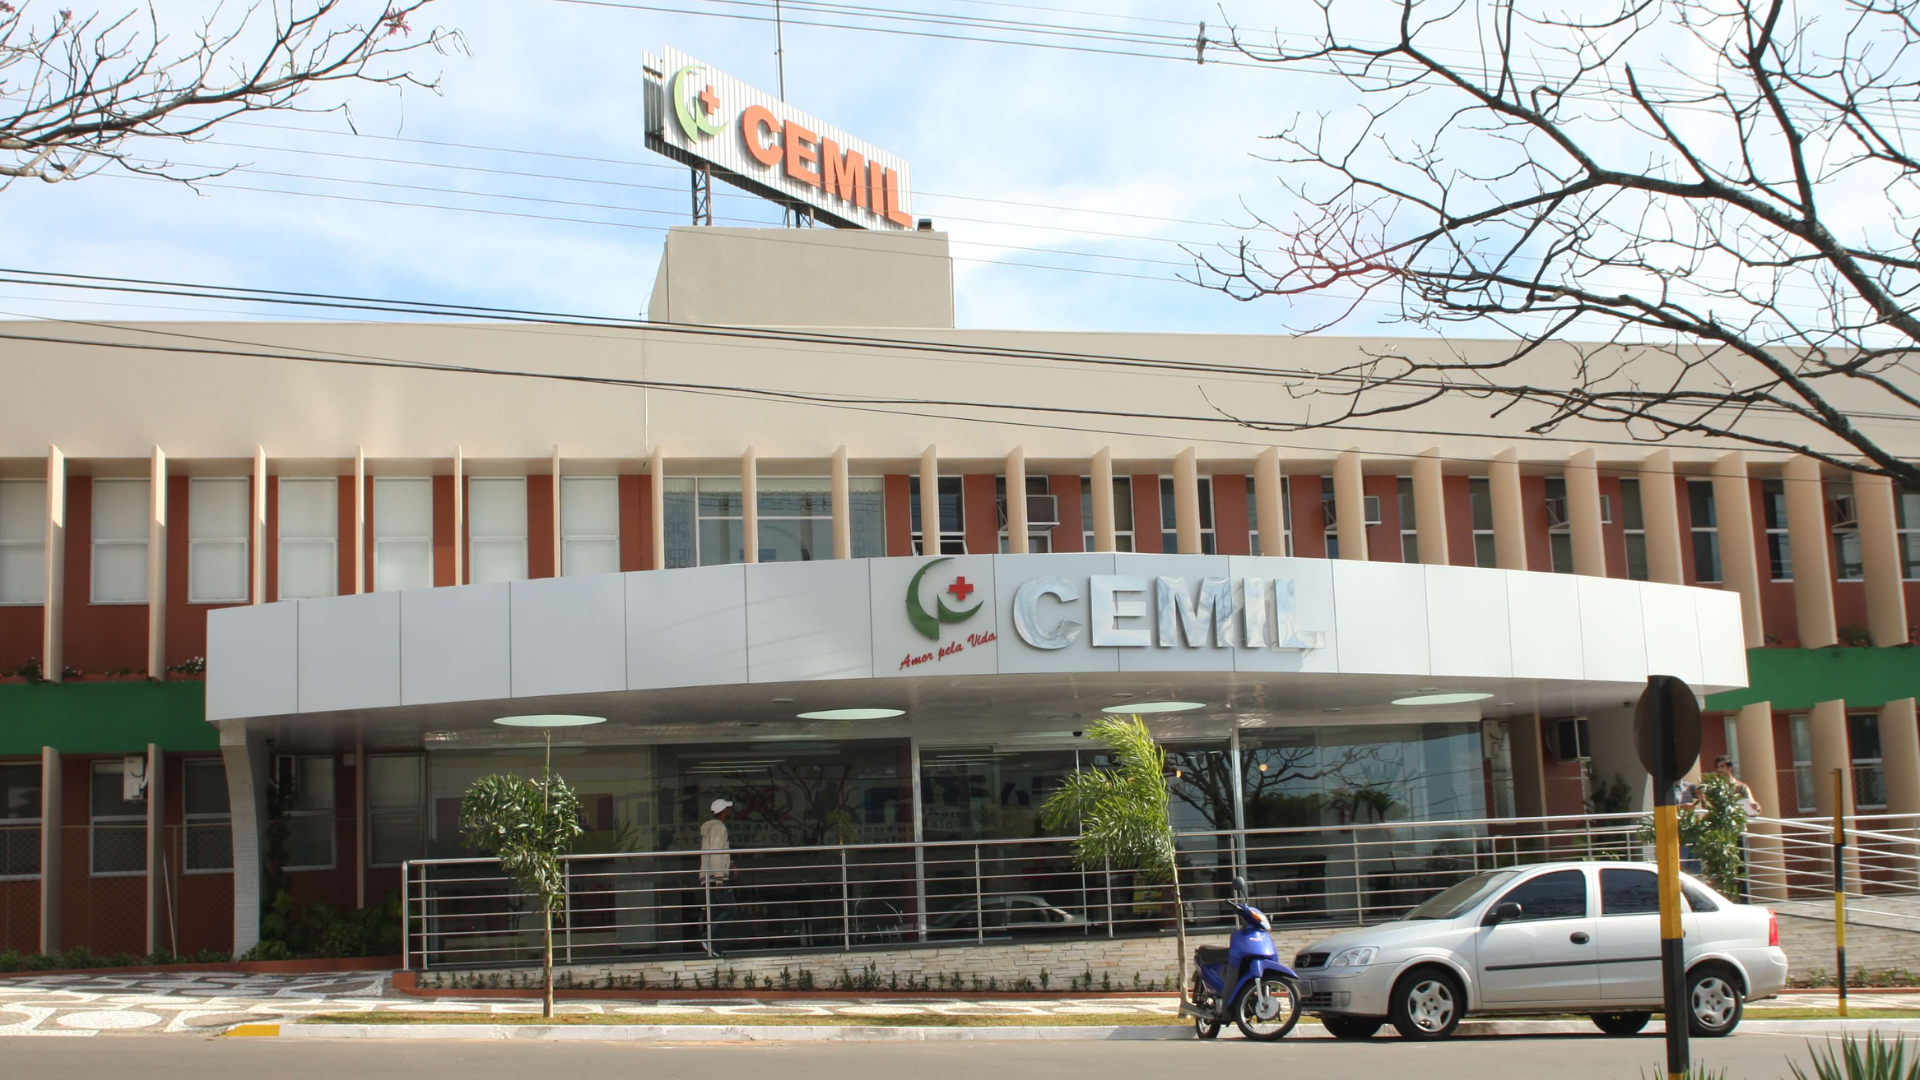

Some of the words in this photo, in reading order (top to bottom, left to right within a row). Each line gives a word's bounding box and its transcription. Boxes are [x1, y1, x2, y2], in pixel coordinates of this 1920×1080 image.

[741, 104, 912, 229] CEMIL
[1013, 575, 1326, 650] CEMIL
[899, 653, 934, 671] Amor
[937, 640, 964, 662] pela
[966, 630, 997, 648] Vida
